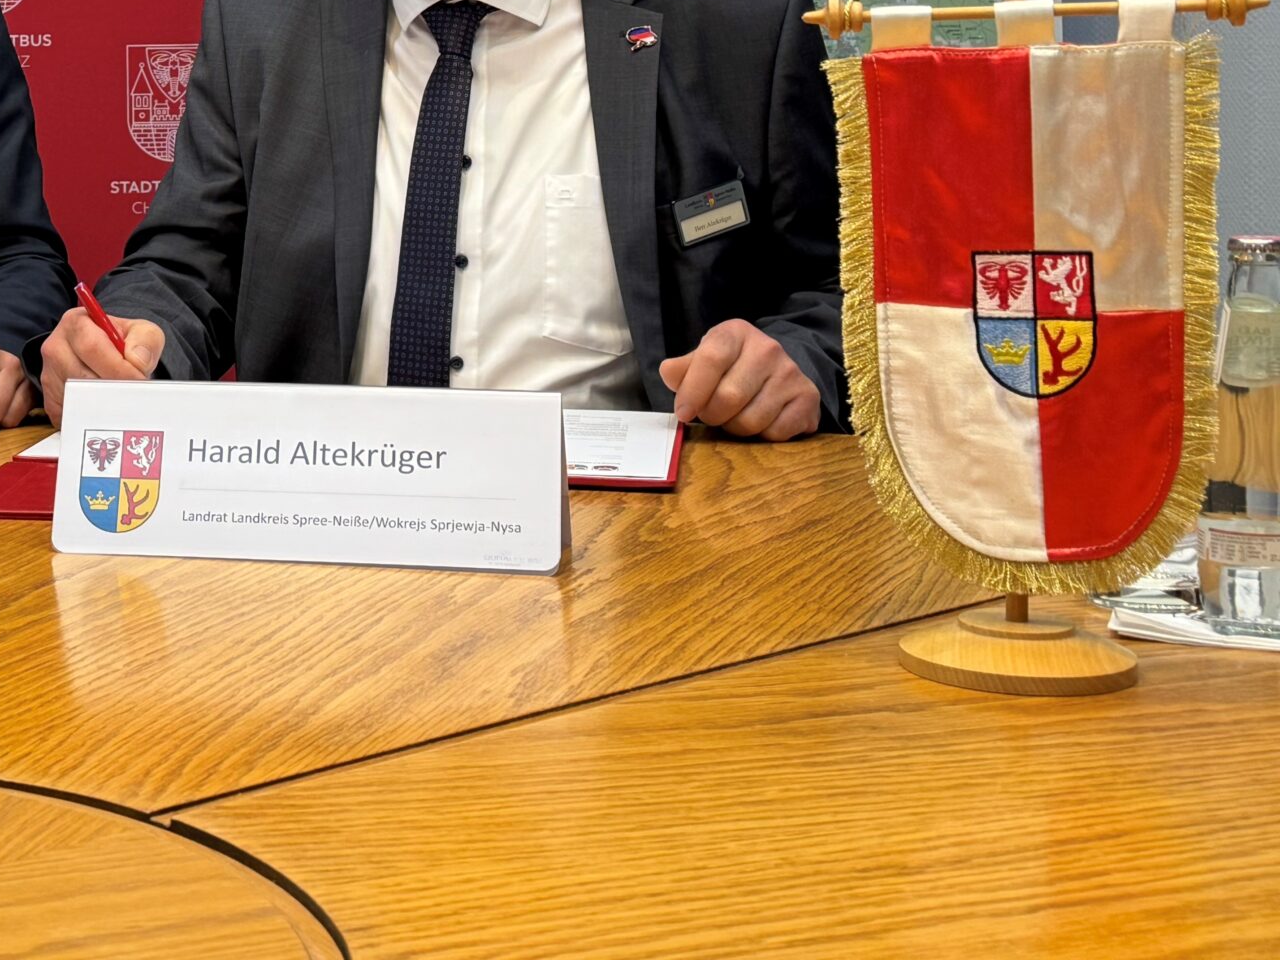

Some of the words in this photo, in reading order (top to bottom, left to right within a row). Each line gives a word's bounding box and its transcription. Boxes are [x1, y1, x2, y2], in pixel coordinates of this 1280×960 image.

[9, 33, 52, 48] TBUS
[188, 438, 281, 465] Harald
[289, 440, 448, 475] Altekrüger
[182, 510, 228, 522] Landrat
[231, 512, 289, 525] Landkreis
[292, 513, 427, 532] Spree-Neiße/Wokrejs
[430, 518, 522, 535] Sprjewja-Nysa
